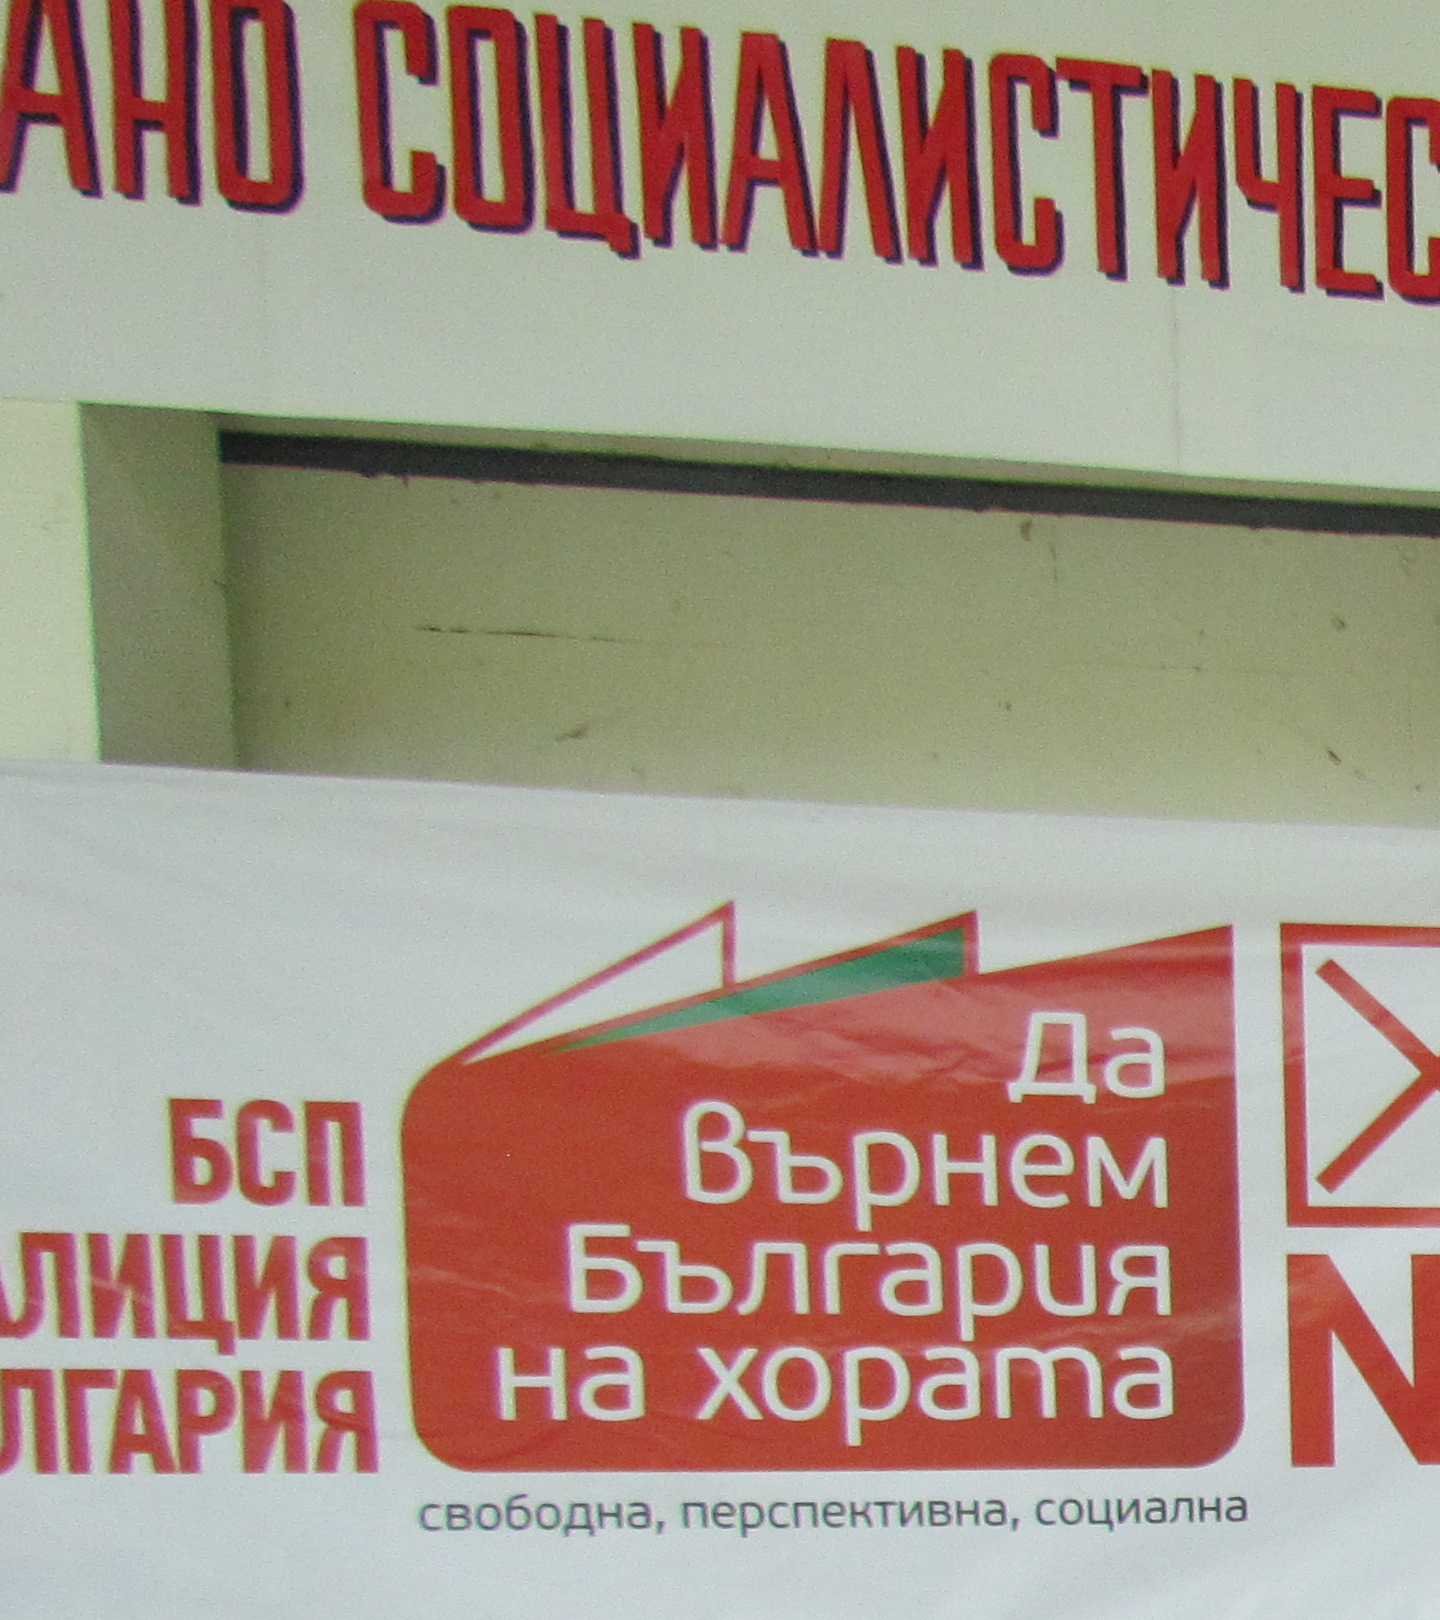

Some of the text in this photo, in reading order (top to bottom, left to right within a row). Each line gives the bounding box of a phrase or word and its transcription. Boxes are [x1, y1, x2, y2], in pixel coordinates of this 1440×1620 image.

[1006, 1010, 1166, 1105] Да
[171, 1098, 365, 1207] БСП
[682, 1101, 1169, 1231] върнем
[0, 1232, 371, 1355] ЛИЦИЯ
[567, 1222, 1173, 1341] България
[497, 1345, 1175, 1446] на хората
[418, 1492, 1247, 1538] свободна, перспективна, социална
